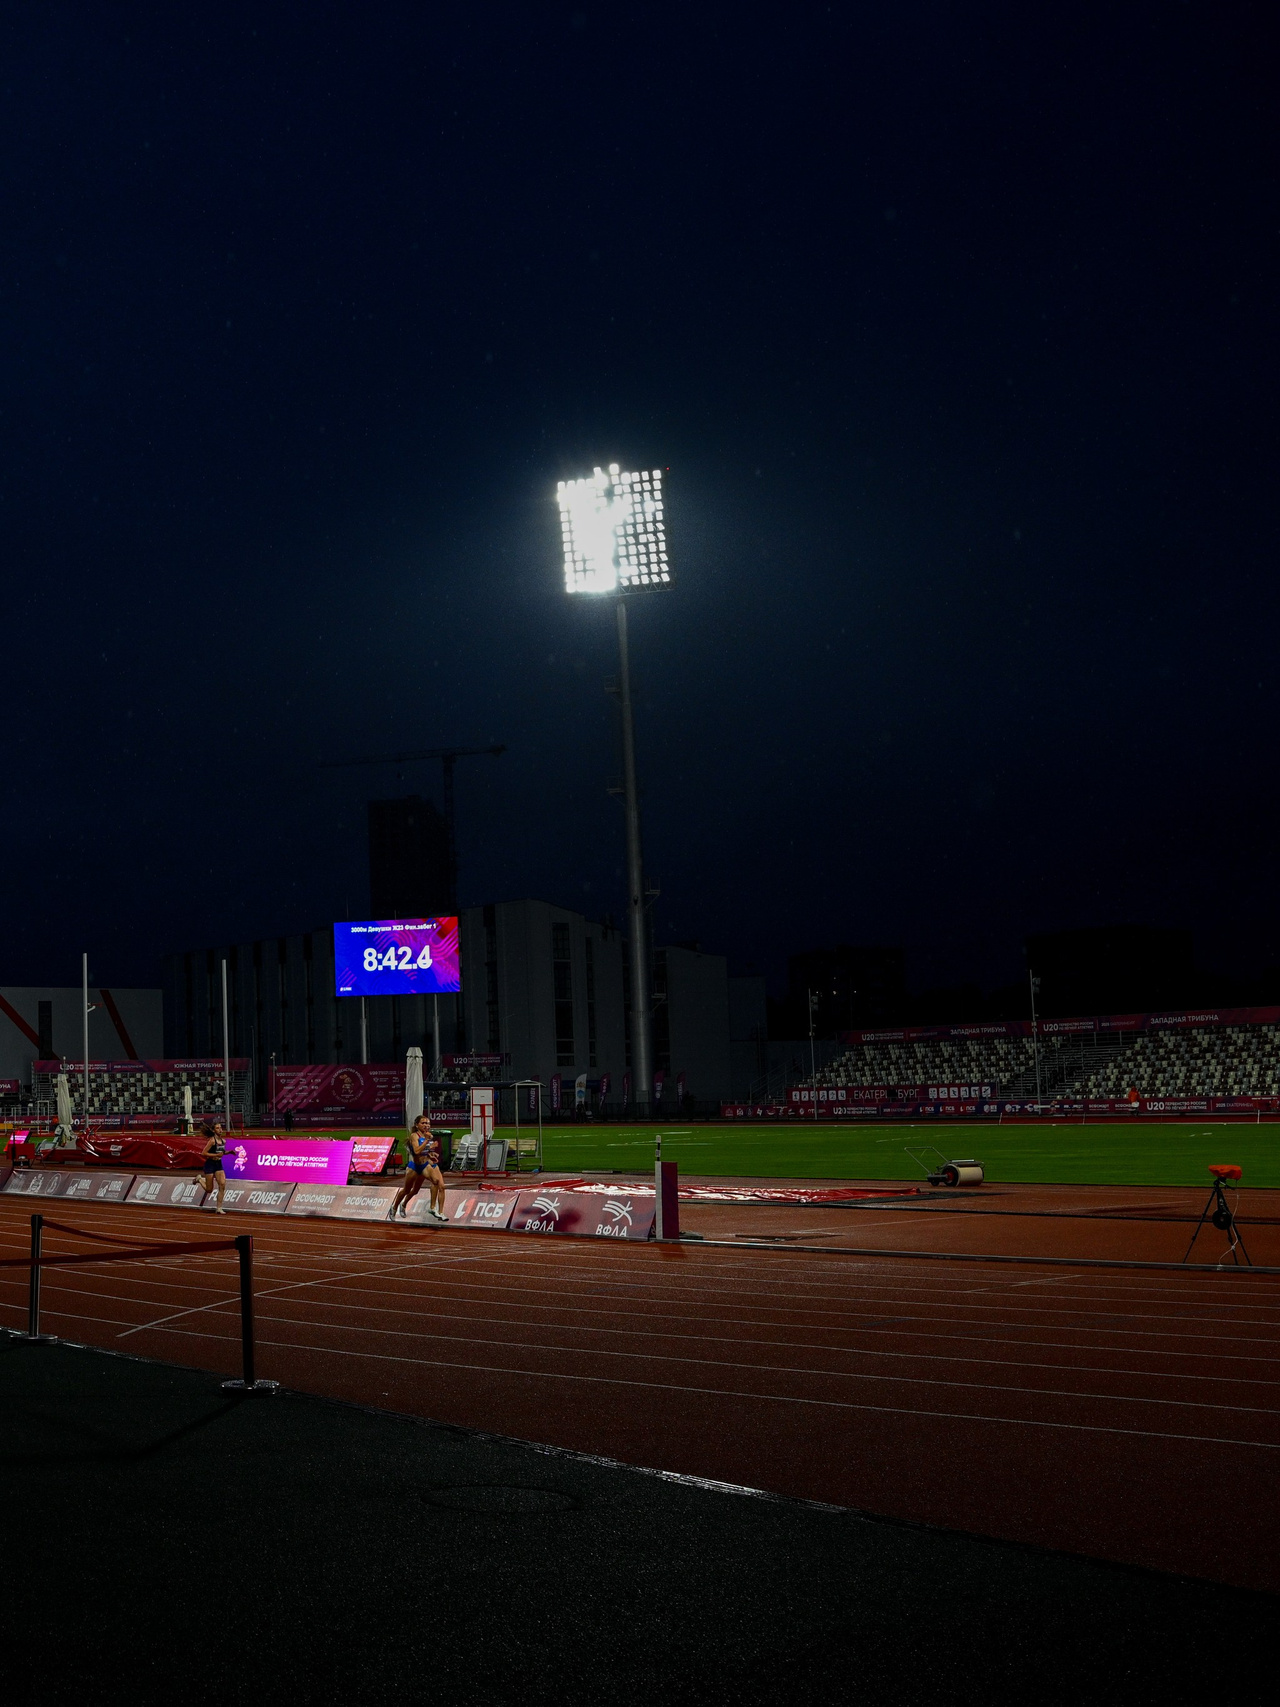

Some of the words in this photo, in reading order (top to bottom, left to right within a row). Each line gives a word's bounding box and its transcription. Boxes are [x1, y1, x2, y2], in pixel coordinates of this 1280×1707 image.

[1151, 1015, 1186, 1024] ЗАПАДНАЯ
[1188, 1014, 1219, 1022] ТРИБУНА
[950, 1028, 980, 1036] ЗАПАДНАЯ
[1043, 1023, 1059, 1031] U20
[1146, 1102, 1165, 1111] U20
[257, 1154, 278, 1166] U20
[246, 1191, 287, 1205] FONBET
[474, 1202, 505, 1218] ПСБ
[525, 1219, 555, 1232] ВФЛА
[596, 1224, 628, 1238] ВФЛА
